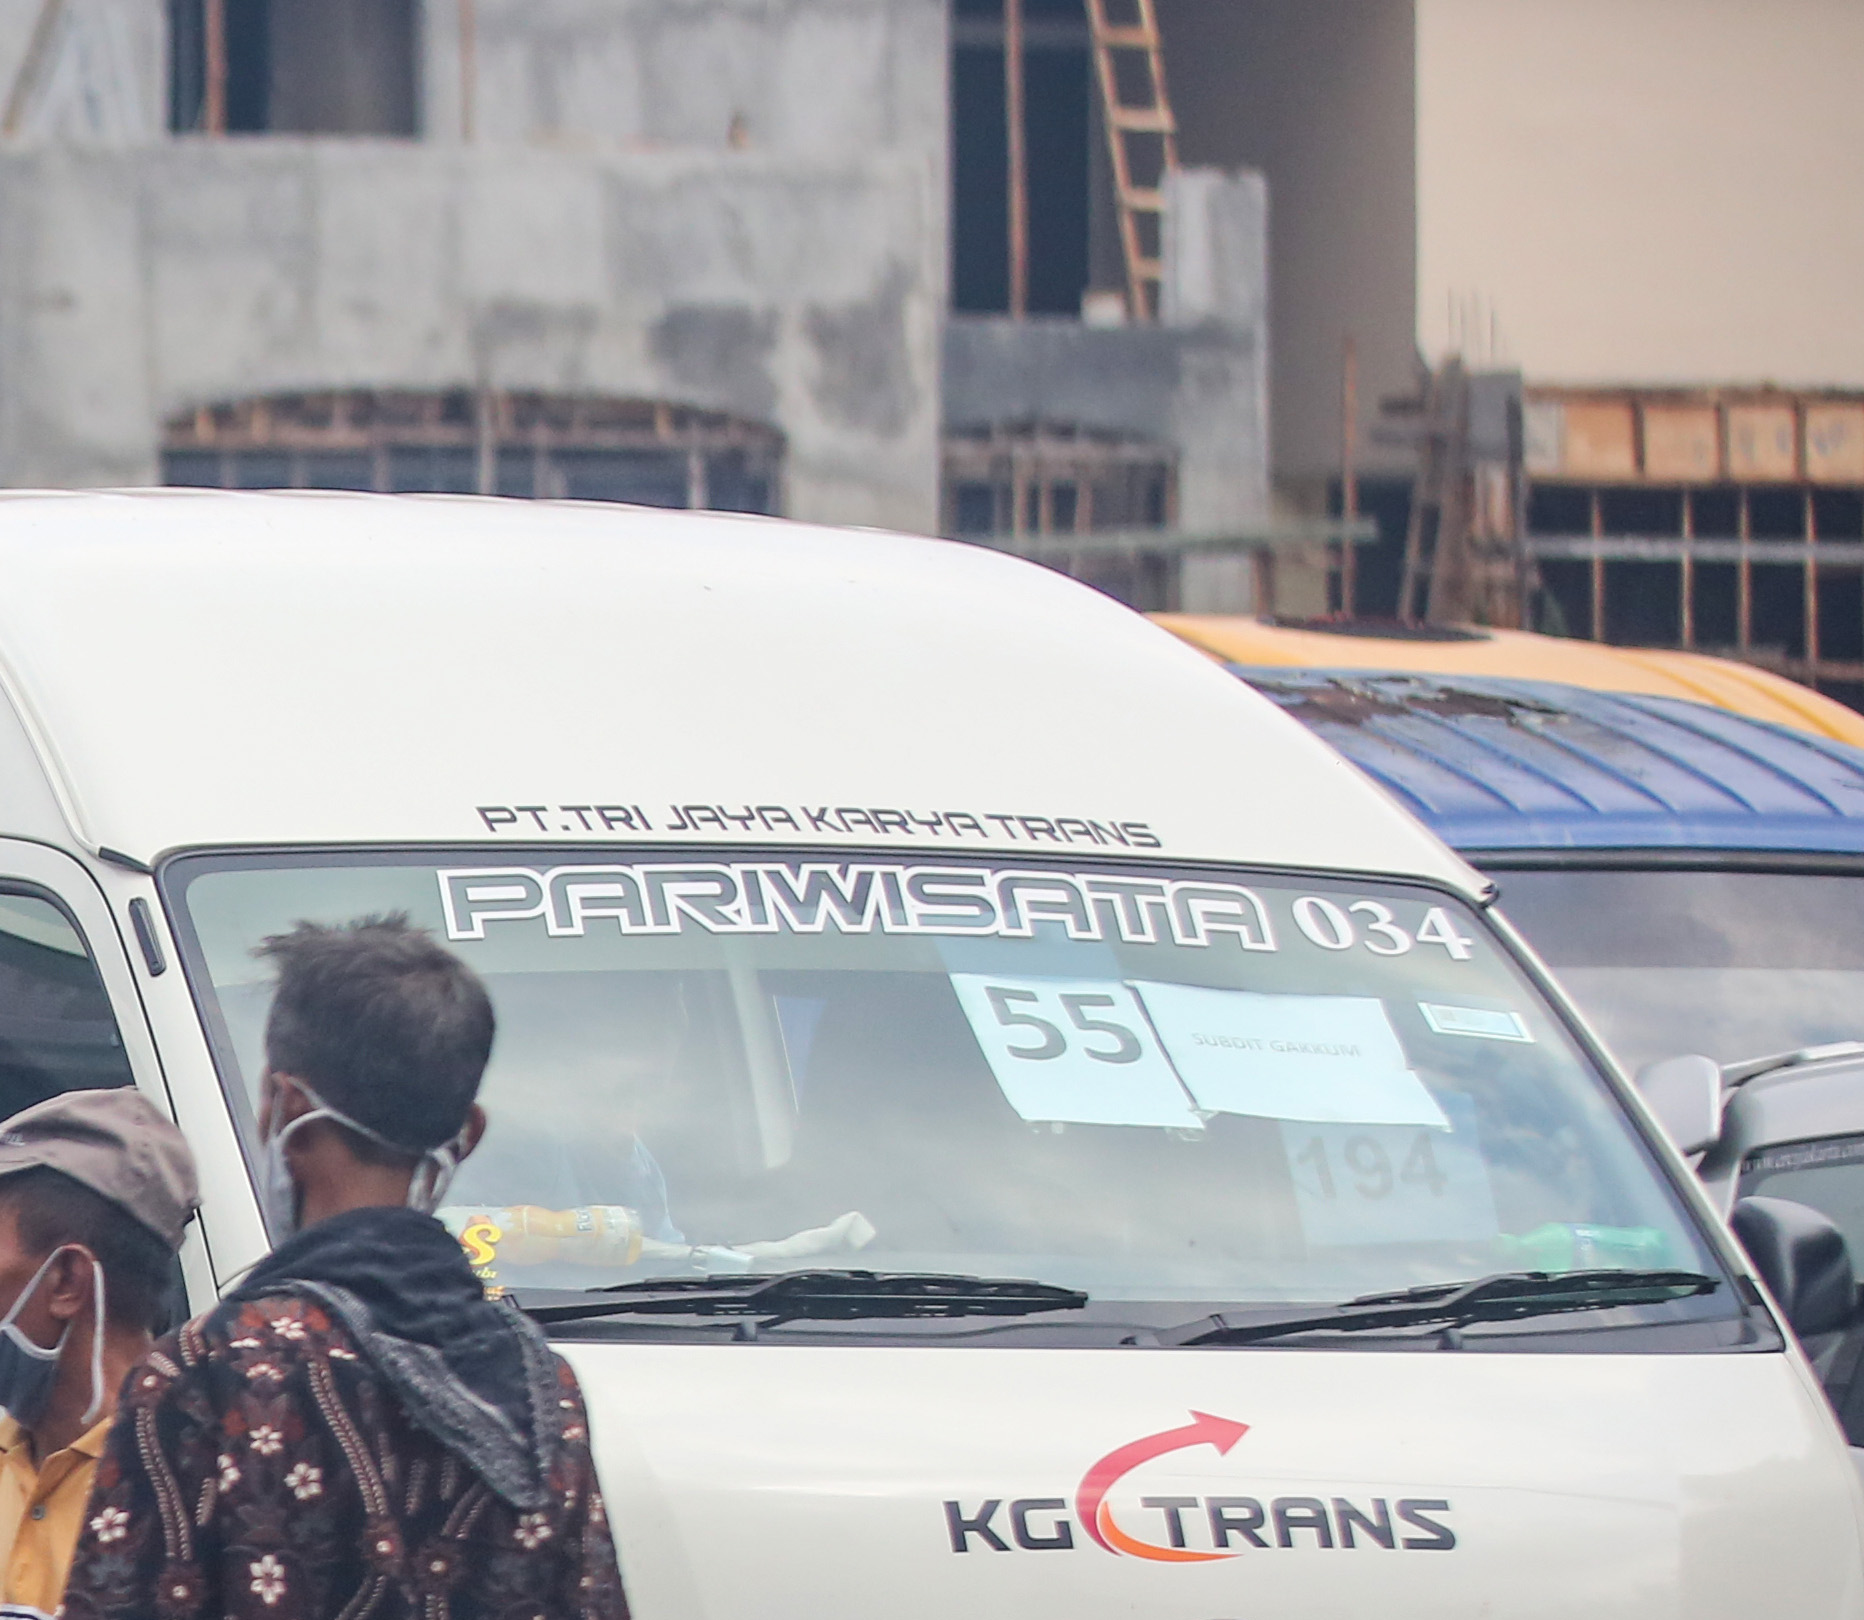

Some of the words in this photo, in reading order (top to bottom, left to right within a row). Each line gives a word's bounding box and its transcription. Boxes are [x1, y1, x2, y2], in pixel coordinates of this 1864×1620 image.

[666, 804, 801, 832] JAYA
[801, 806, 985, 838] KARYA
[983, 813, 1163, 849] TRANS
[435, 862, 1278, 952] PARIWISATA
[1291, 896, 1473, 961] 034
[983, 985, 1143, 1065] 55
[1191, 1032, 1264, 1054] SUBDIT
[1297, 1132, 1449, 1202] 194
[943, 1497, 1075, 1552] KG
[1139, 1496, 1457, 1552] TRANS
